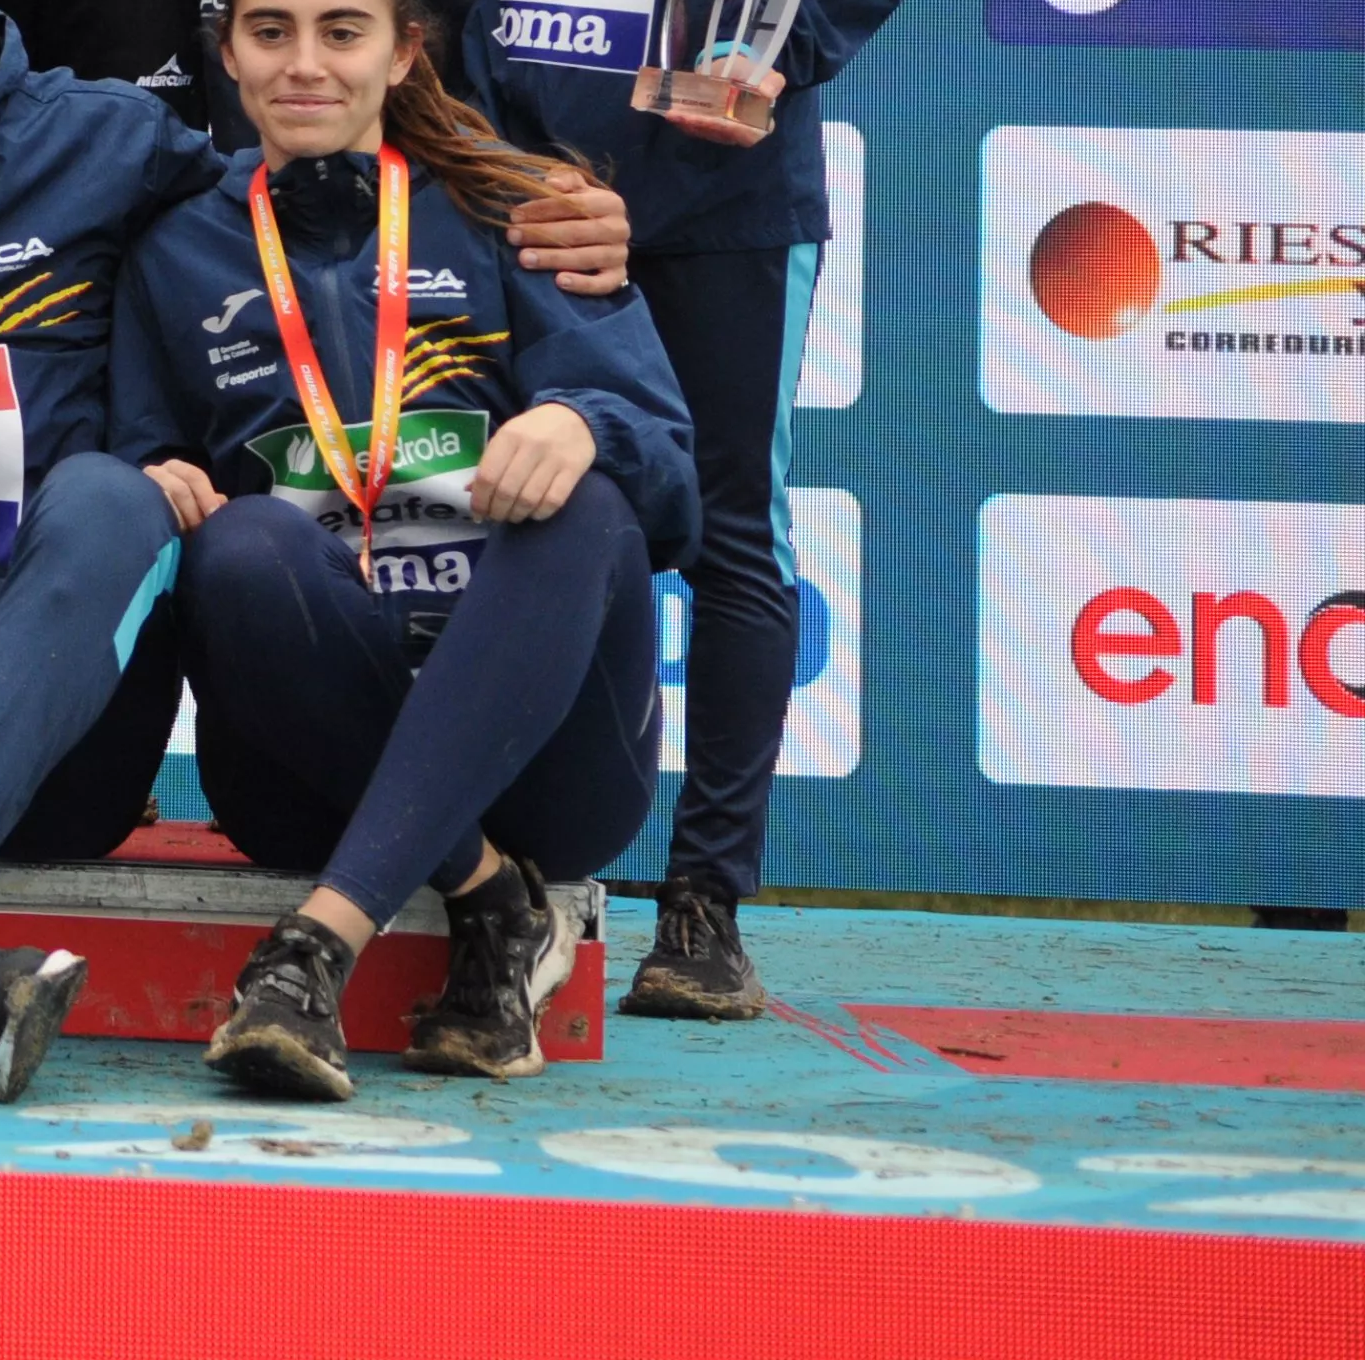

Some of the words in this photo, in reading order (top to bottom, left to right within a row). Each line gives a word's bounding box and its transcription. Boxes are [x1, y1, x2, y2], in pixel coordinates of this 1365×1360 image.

[135, 74, 194, 88] MERCURY
[388, 163, 400, 248] ATLETISMO
[388, 248, 401, 295] RFEA
[300, 363, 337, 446] ATLETISMO
[379, 348, 396, 437] ATLETISMO
